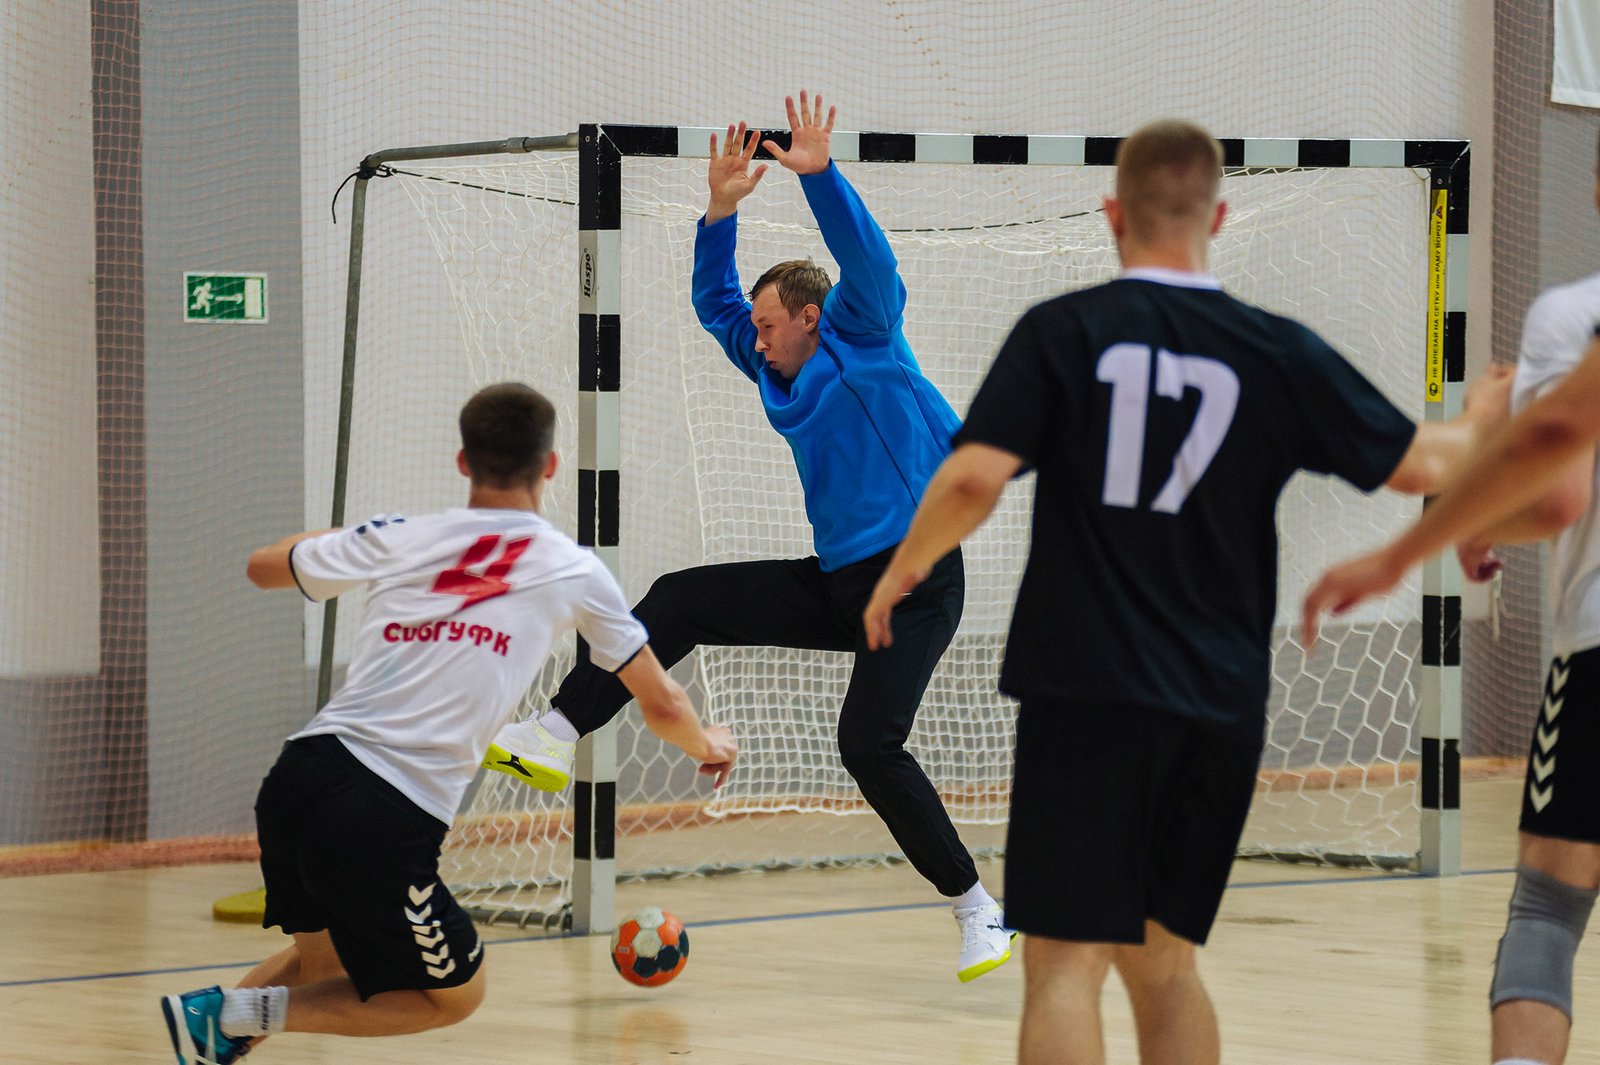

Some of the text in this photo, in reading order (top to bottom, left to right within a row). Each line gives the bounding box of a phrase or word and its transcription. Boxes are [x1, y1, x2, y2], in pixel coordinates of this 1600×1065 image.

[1434, 221, 1442, 249] ВОРОТ
[1433, 319, 1439, 331] НА
[1432, 367, 1438, 379] НЕ
[1095, 341, 1241, 515] 17
